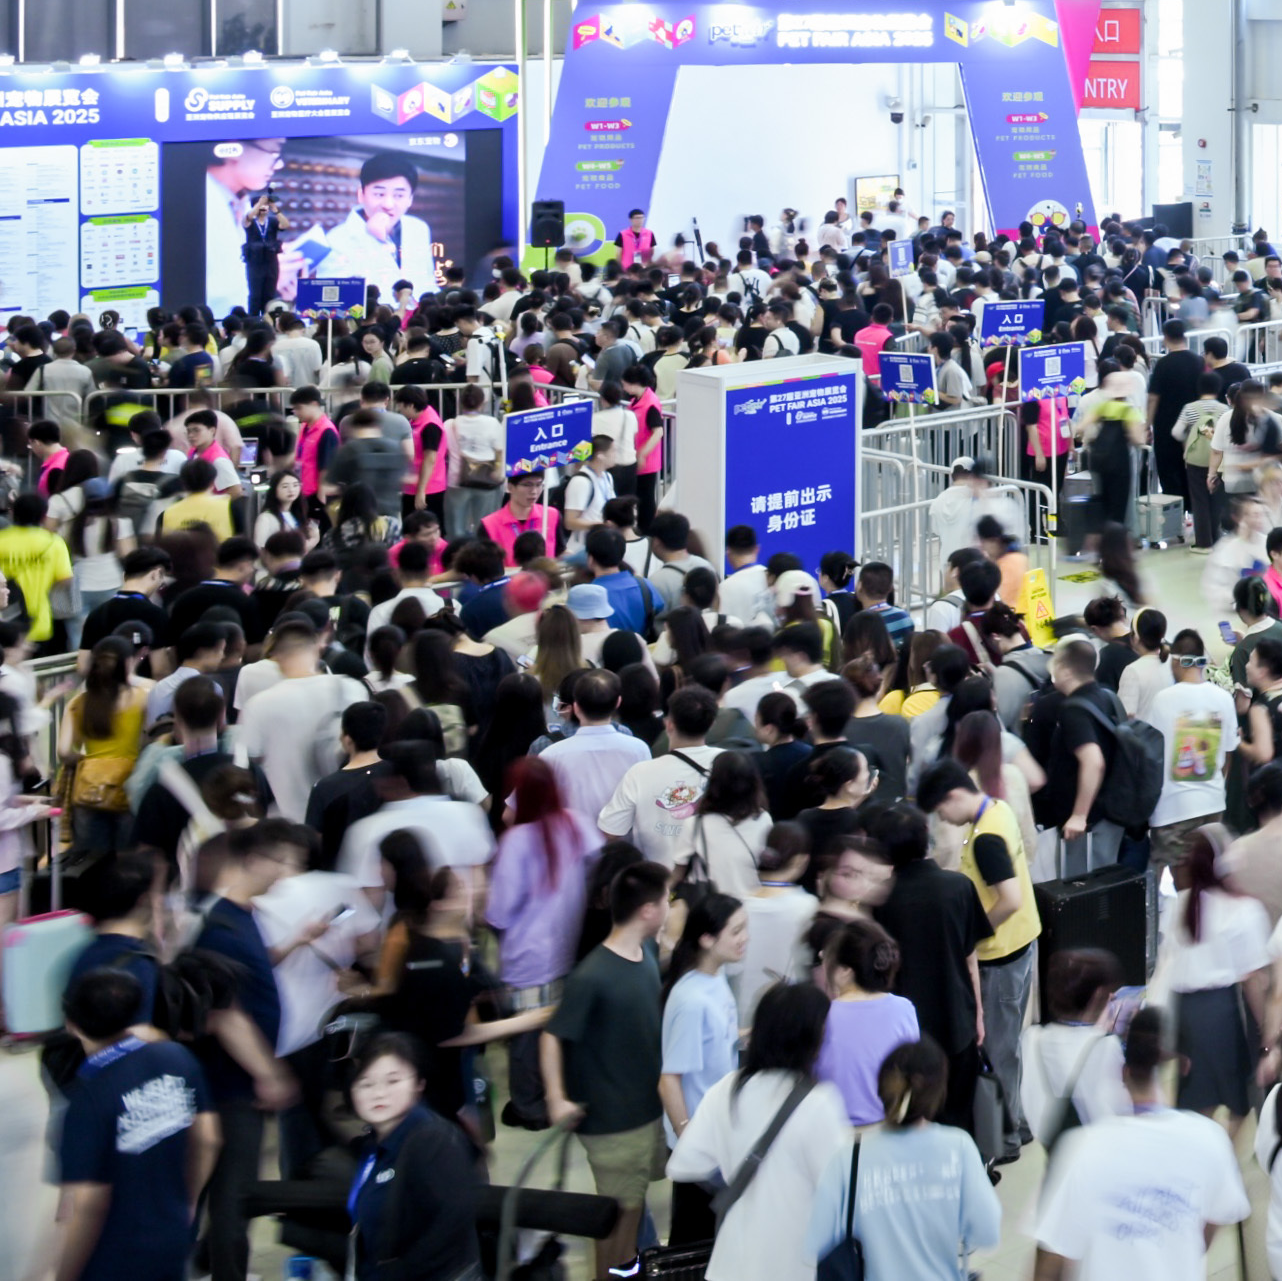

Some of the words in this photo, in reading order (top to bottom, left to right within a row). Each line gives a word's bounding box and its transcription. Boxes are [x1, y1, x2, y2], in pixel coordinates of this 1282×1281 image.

[1085, 78, 1128, 99] NTRY
[53, 109, 100, 124] 2025
[1002, 314, 1023, 325] 入口
[770, 403, 786, 413] PET
[787, 401, 806, 411] FAIR
[807, 398, 826, 408] ASIA
[828, 395, 847, 404] 2025
[534, 424, 563, 441] 入口
[530, 440, 567, 452] Entrance
[751, 484, 832, 513] 请提前出示
[767, 508, 816, 533] 身份证
